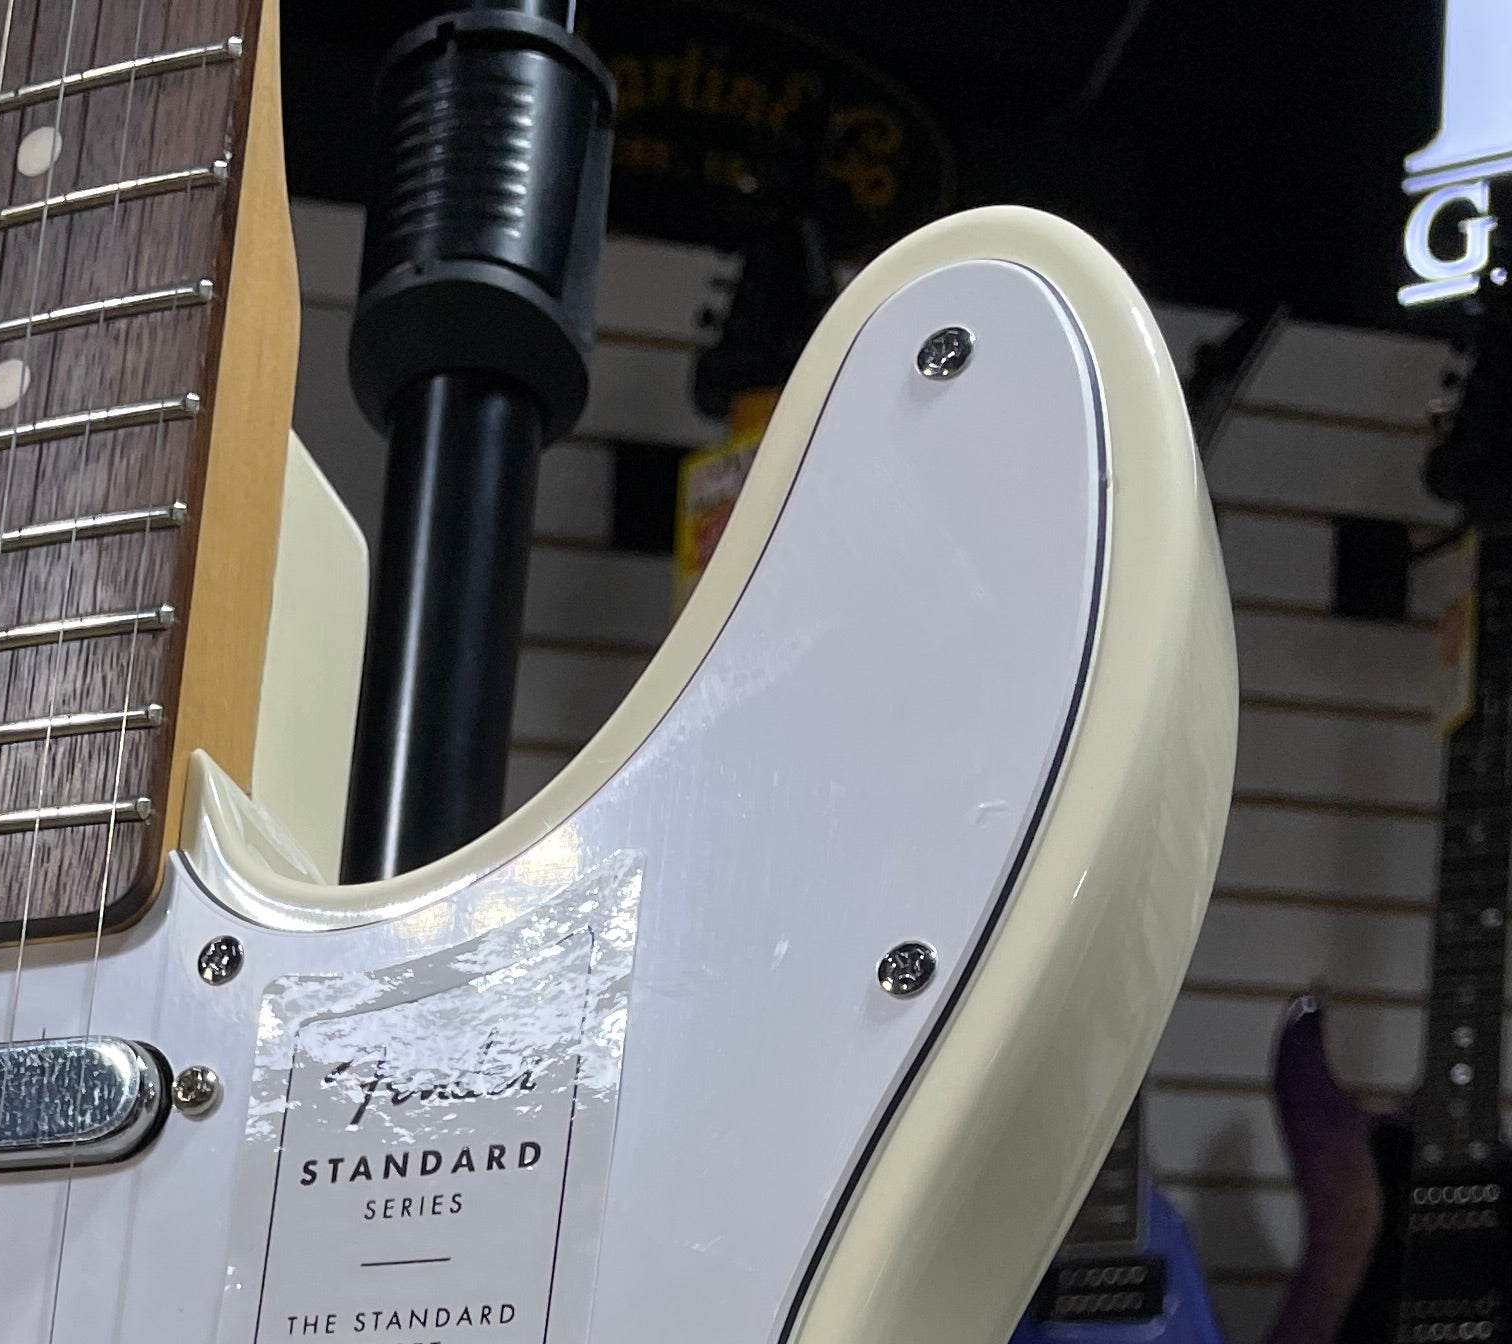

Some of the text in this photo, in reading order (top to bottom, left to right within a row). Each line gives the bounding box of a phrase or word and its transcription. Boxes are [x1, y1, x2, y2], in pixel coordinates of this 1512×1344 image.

[300, 1141, 541, 1186] STANDARD
[364, 1193, 462, 1220] SERIES
[287, 1303, 515, 1336] THE STANDARD
